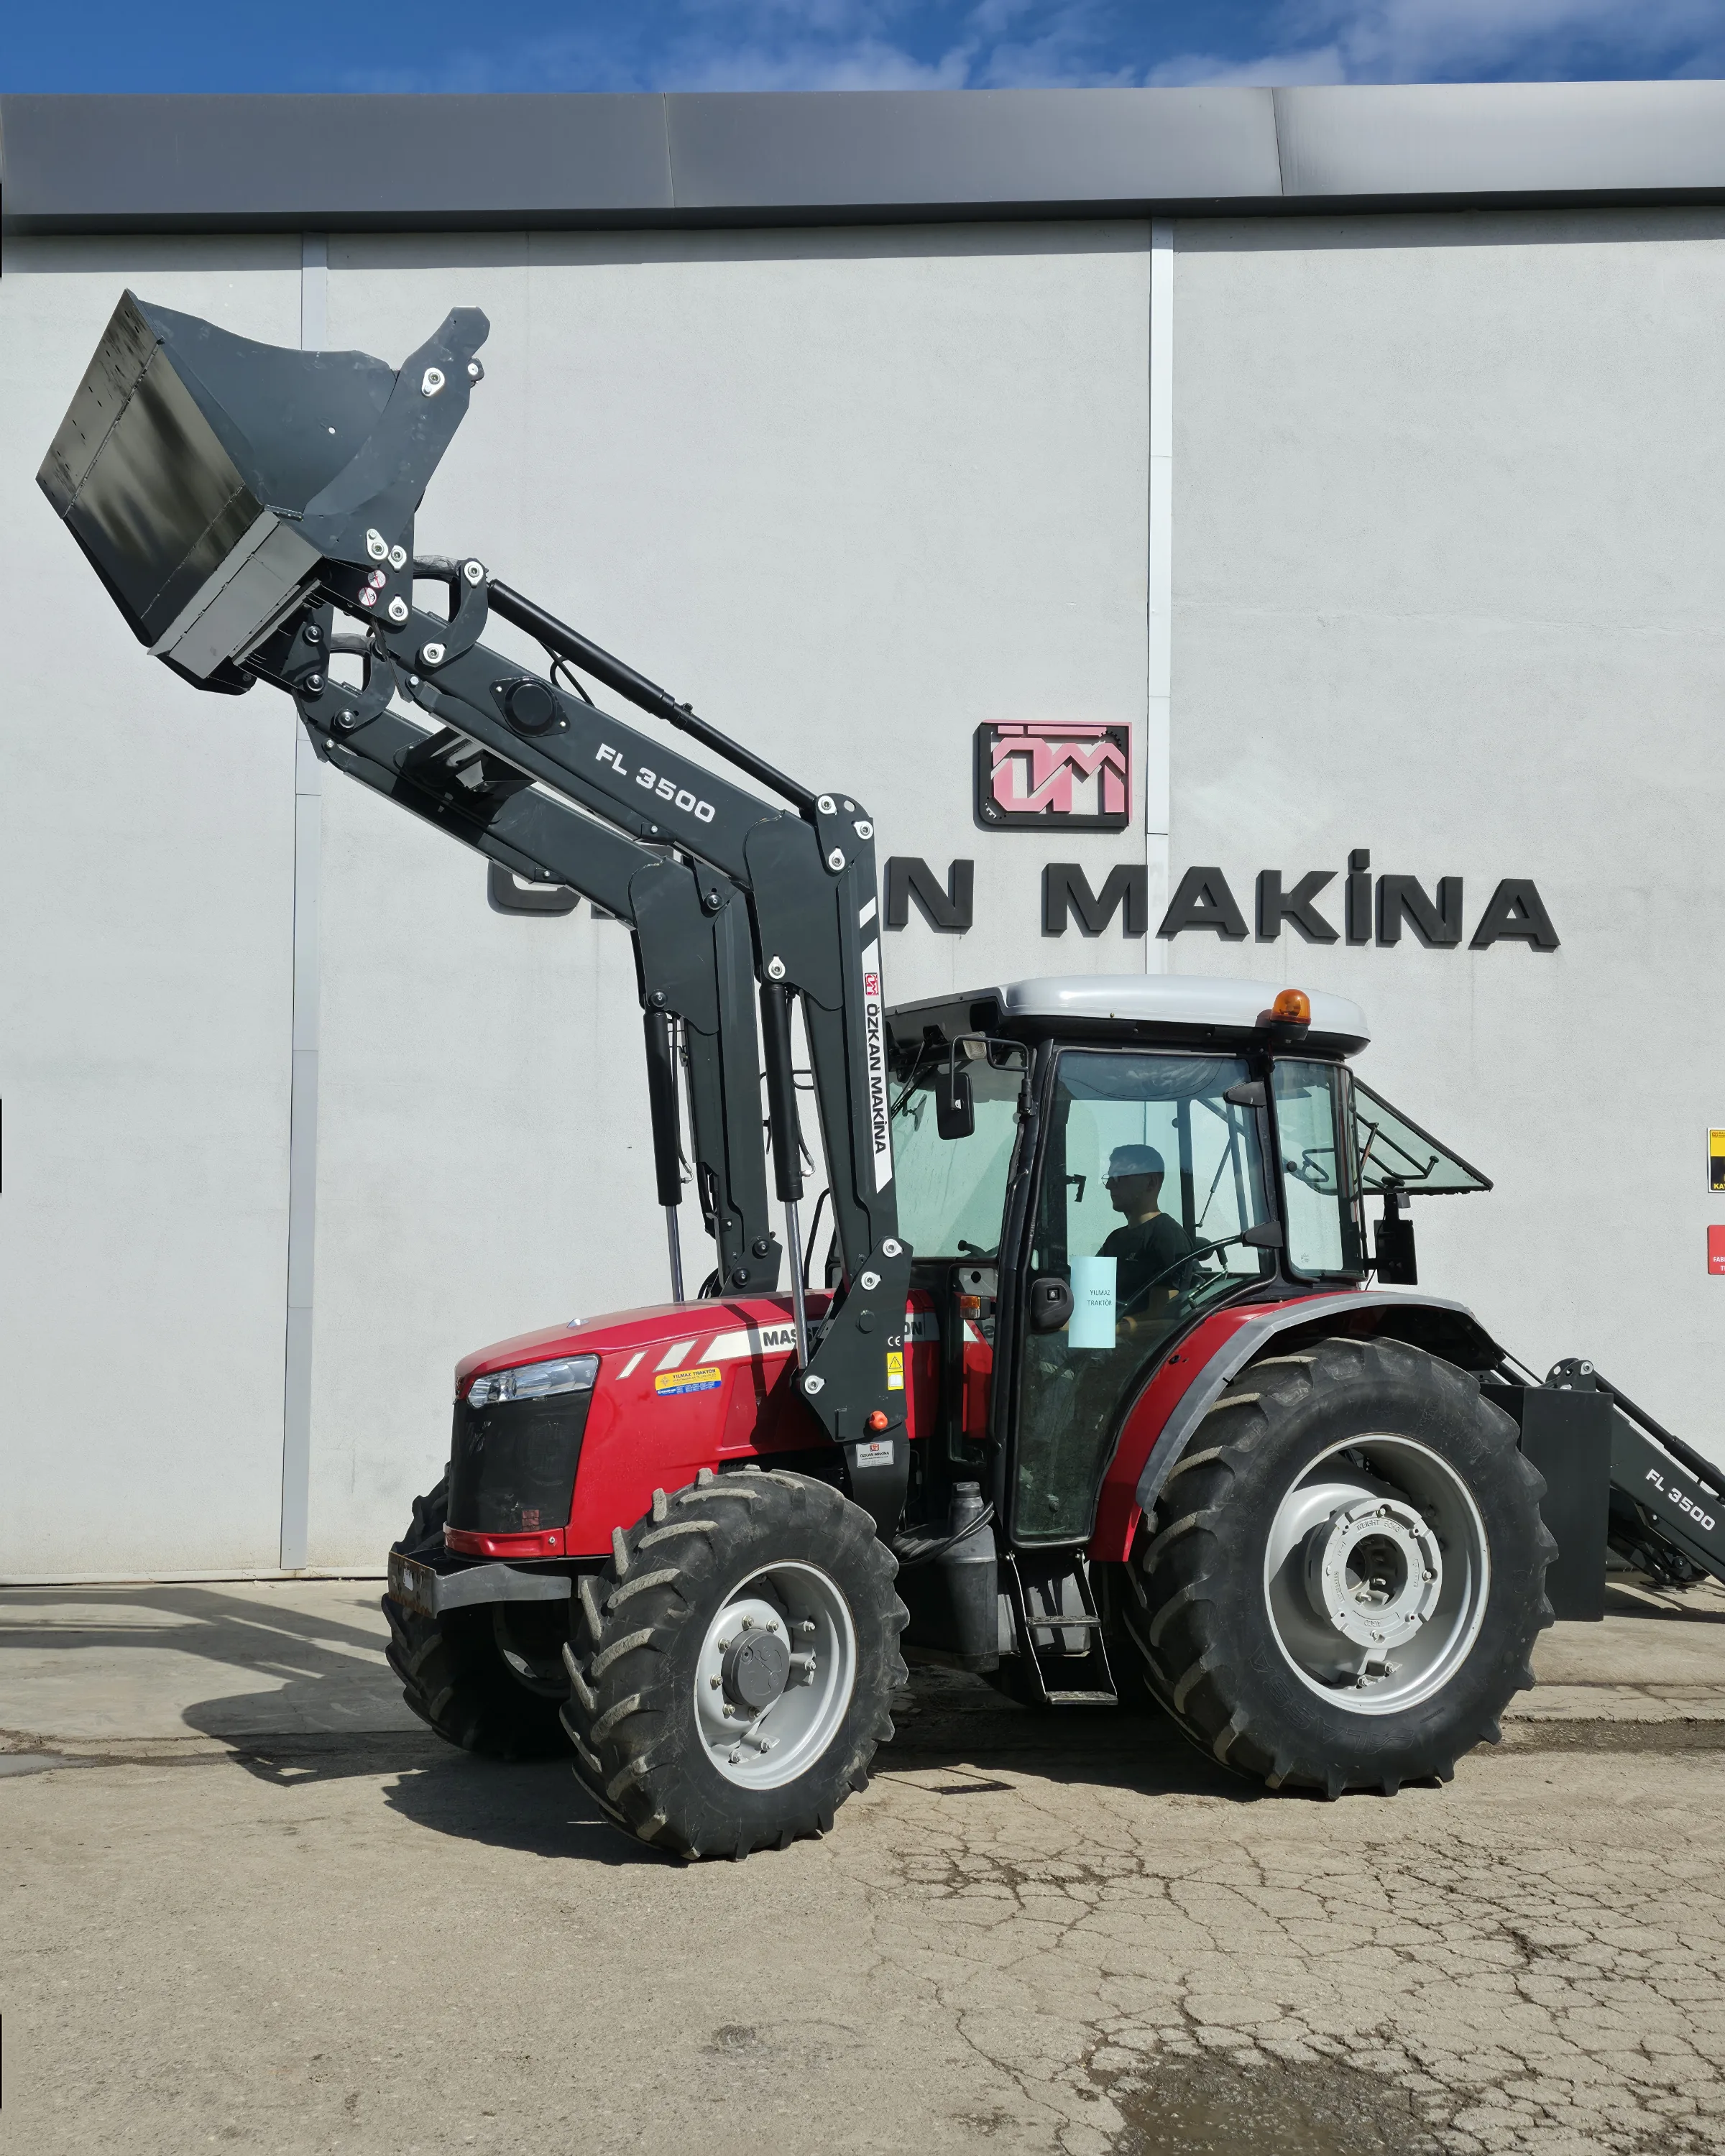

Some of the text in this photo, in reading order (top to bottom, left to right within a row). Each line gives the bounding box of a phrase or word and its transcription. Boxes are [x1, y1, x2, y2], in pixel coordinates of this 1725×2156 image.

[595, 742, 716, 823] FL 3500
[1046, 848, 1560, 948] MAKİNA
[866, 1003, 888, 1155] ÖZKAN MAKİNA
[1356, 1519, 1381, 1531] WEIGHT
[1645, 1468, 1716, 1531] FL 3500
